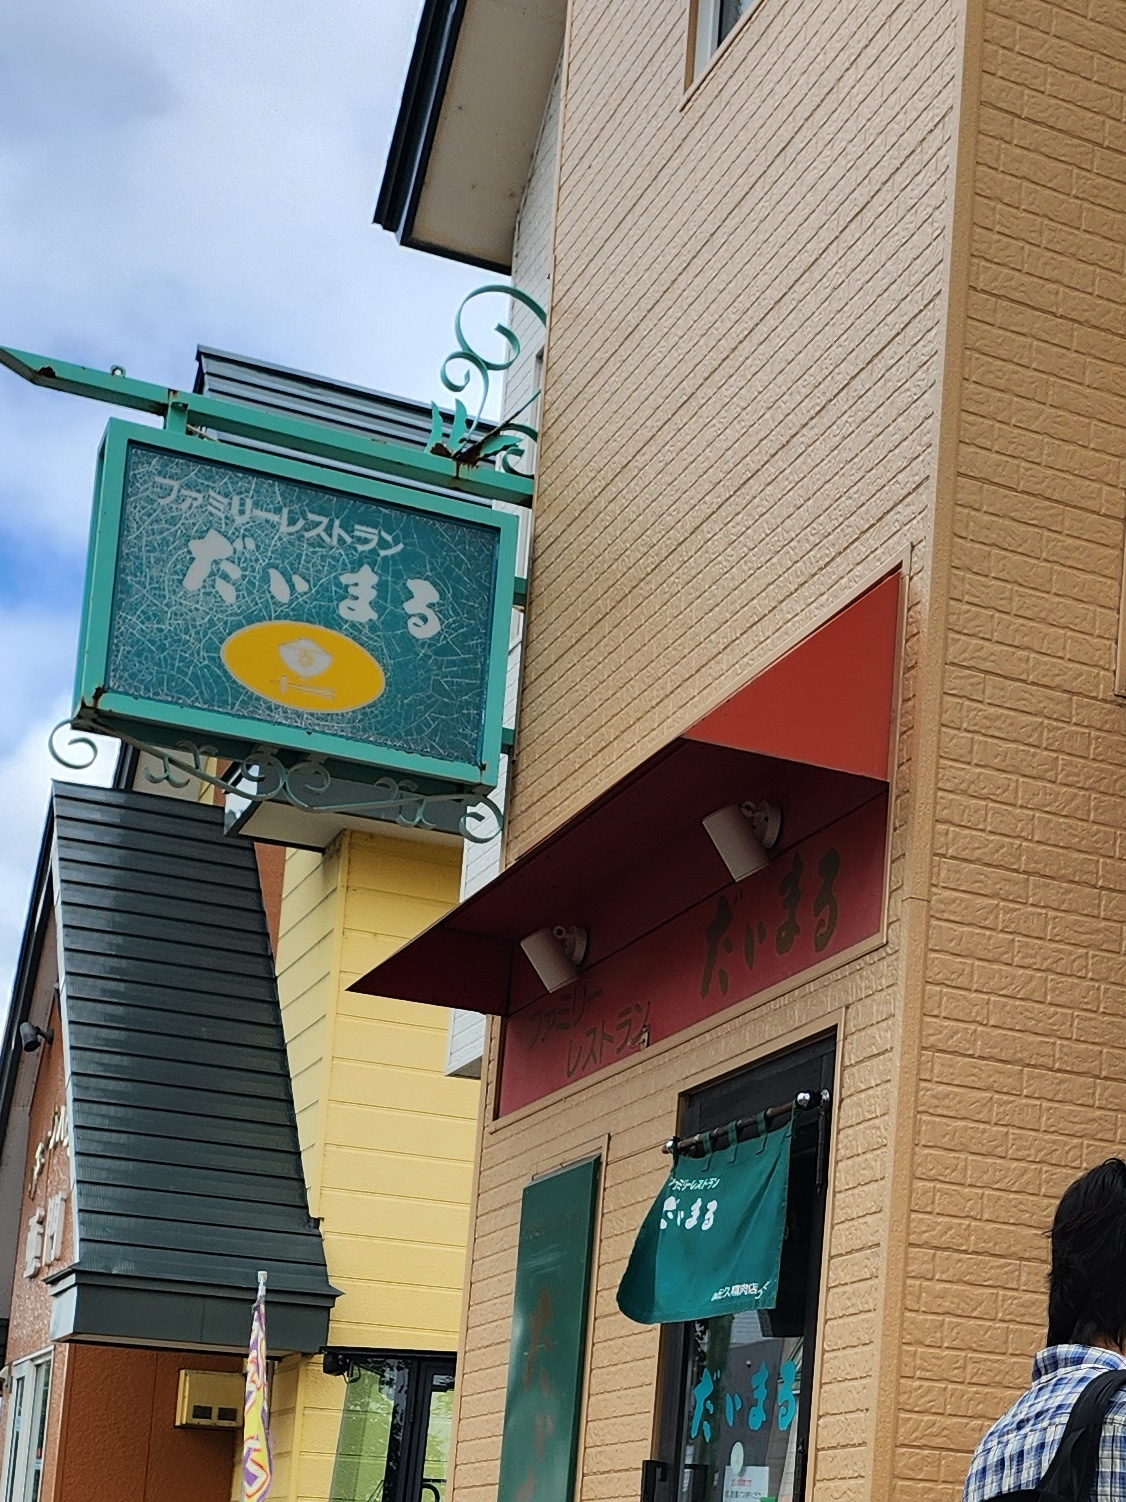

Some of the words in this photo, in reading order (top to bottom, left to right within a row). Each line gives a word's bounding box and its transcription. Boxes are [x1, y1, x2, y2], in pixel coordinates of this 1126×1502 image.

[154, 477, 404, 557] ファミリーレストラン
[182, 528, 441, 640] だいまる
[702, 848, 841, 999] だいまる
[566, 1001, 651, 1078] レストラン
[660, 1196, 718, 1231] だいまる
[668, 1177, 720, 1191] ファミリーレストラン
[691, 1360, 796, 1443] だいまる
